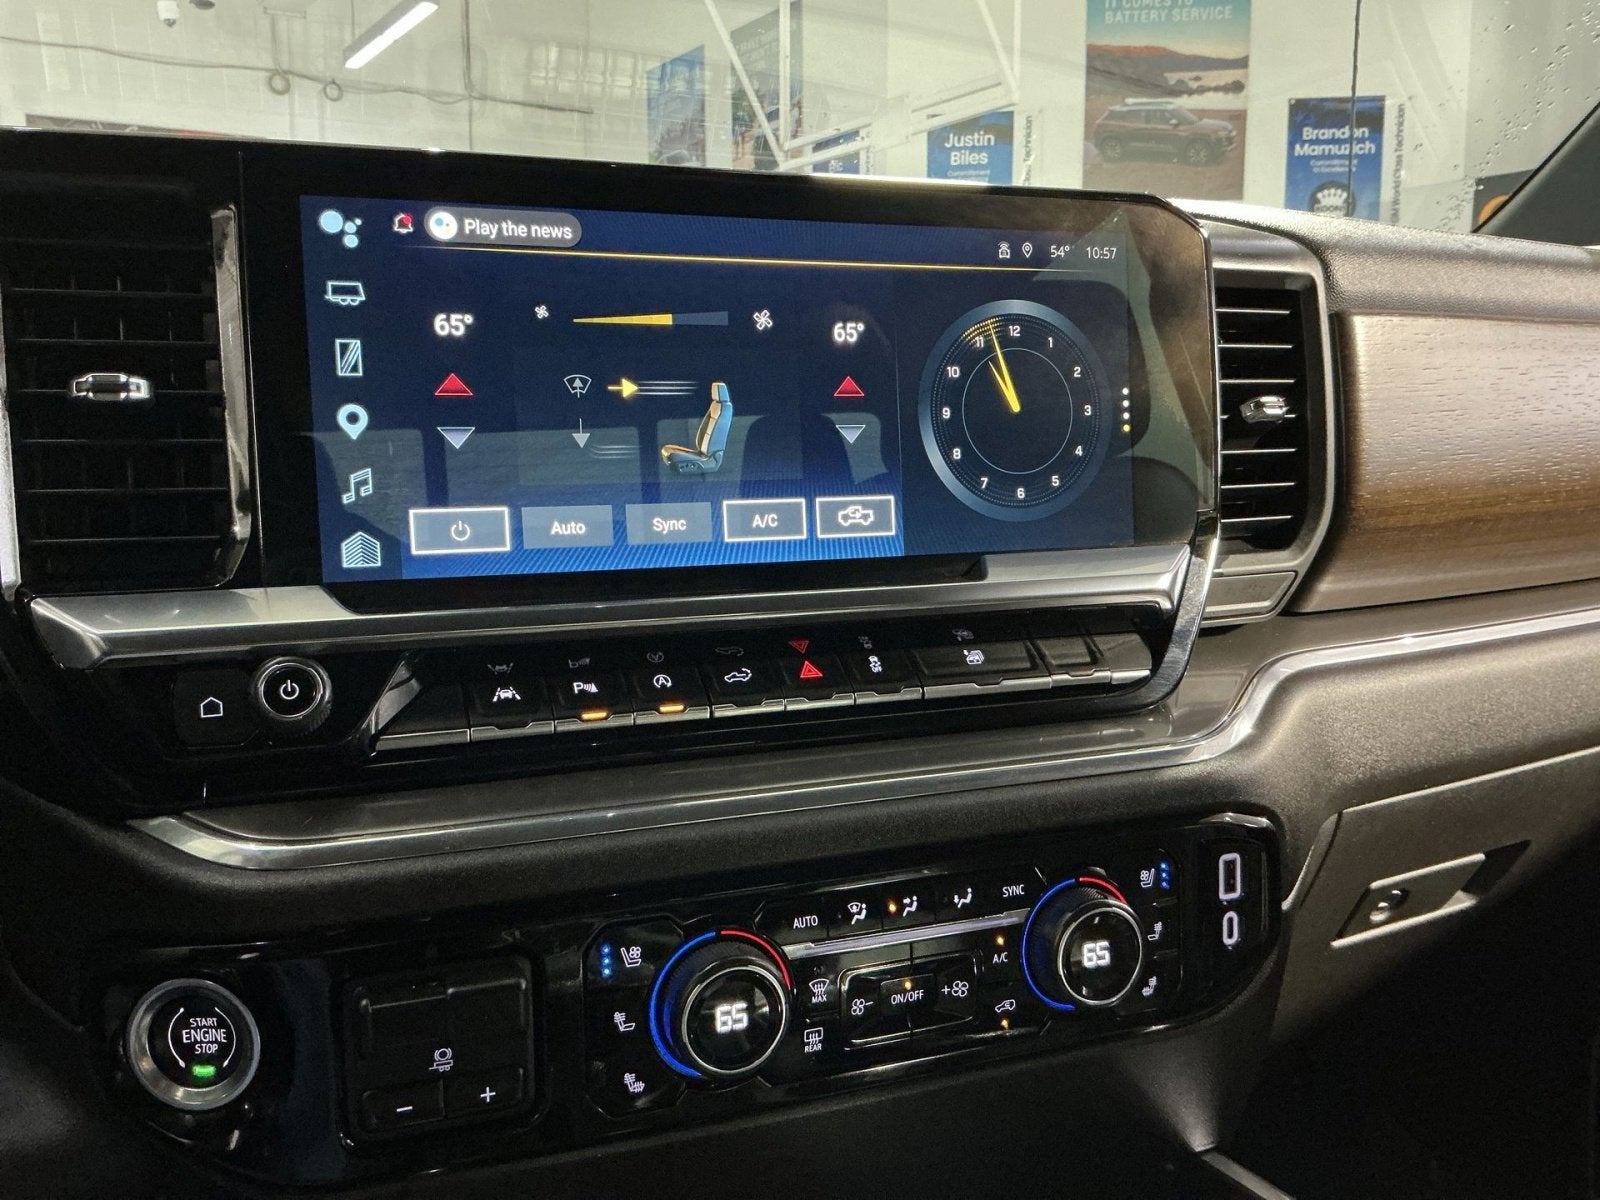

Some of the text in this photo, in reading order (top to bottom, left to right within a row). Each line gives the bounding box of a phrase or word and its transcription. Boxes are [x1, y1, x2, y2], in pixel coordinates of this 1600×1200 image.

[1104, 5, 1233, 25] BATTERY SERVICE
[944, 129, 995, 148] Justin
[950, 149, 988, 166] Biles
[464, 218, 572, 239] Play the news
[1086, 246, 1117, 261] 10:57
[1009, 325, 1021, 337] 12
[947, 366, 960, 378] 10
[1073, 366, 1081, 378] 2
[942, 407, 950, 419] 9
[1084, 404, 1092, 416] 3
[953, 448, 961, 460] 8
[1074, 445, 1083, 457] 4
[980, 477, 988, 490] 7
[1052, 475, 1060, 487] 5
[1017, 486, 1025, 499] 6
[652, 517, 687, 536] Sync
[752, 512, 779, 529] A/C
[551, 520, 586, 537] Auto
[1002, 884, 1025, 898] SYNC
[793, 915, 819, 930] AUTO
[992, 952, 1008, 965] A/C
[1082, 941, 1111, 969] 65
[811, 994, 828, 1004] MAX
[890, 989, 925, 1005] ON/OFF
[190, 1018, 217, 1028] START
[715, 1001, 748, 1034] 65
[182, 1029, 227, 1043] ENGINE
[194, 1043, 219, 1054] STOP
[804, 1042, 823, 1053] REAR
